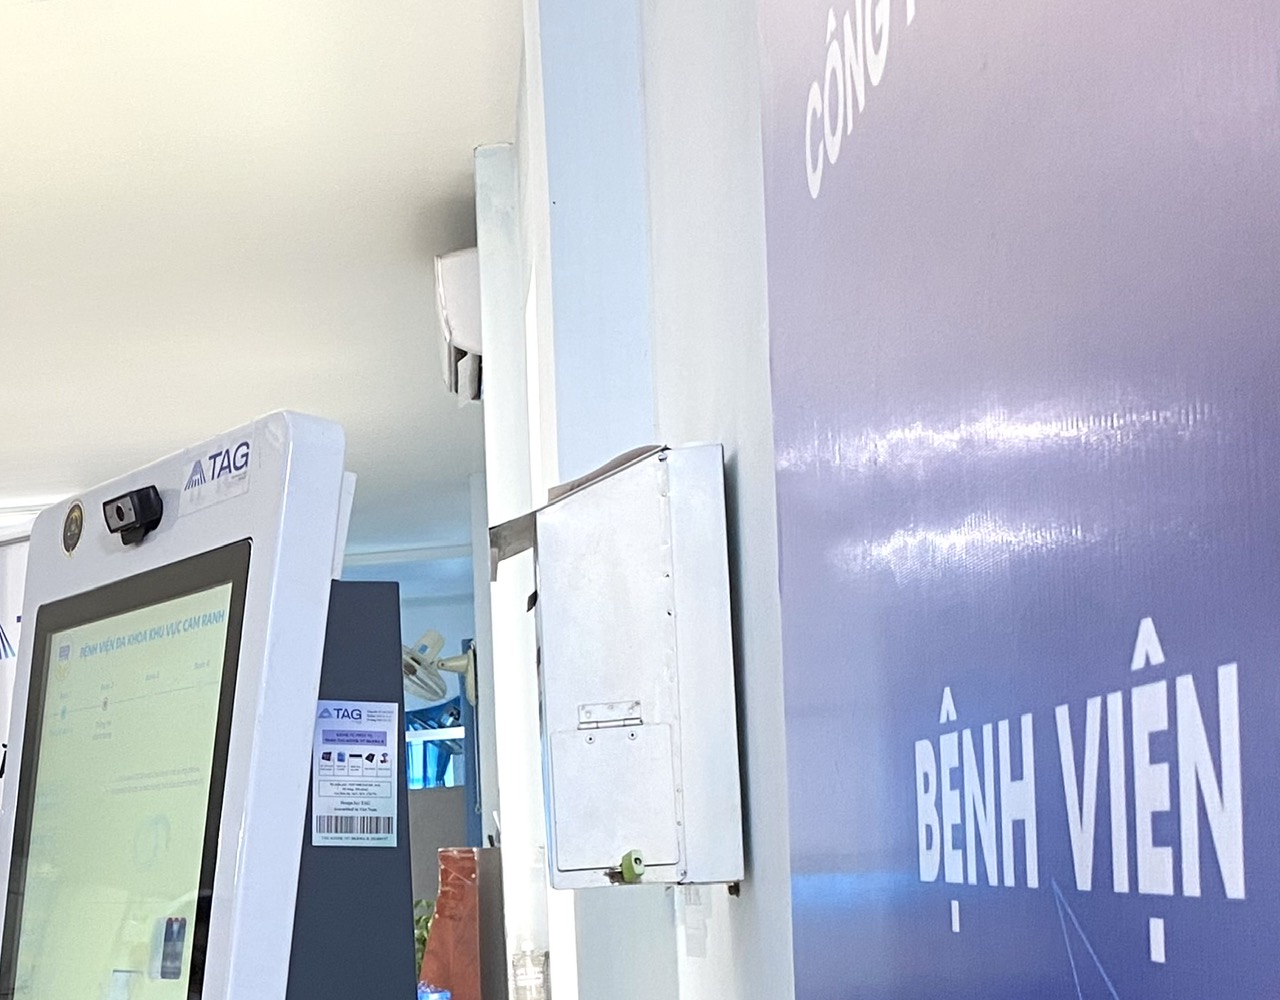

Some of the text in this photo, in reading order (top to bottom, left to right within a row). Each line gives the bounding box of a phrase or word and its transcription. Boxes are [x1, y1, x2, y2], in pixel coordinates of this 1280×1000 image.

[805, 0, 891, 200] CÔNG
[208, 440, 251, 481] TAG
[182, 616, 201, 633] CAM
[201, 609, 226, 628] RANH
[333, 707, 363, 721] TAG
[914, 616, 1247, 964] BỆNH VIỆN
